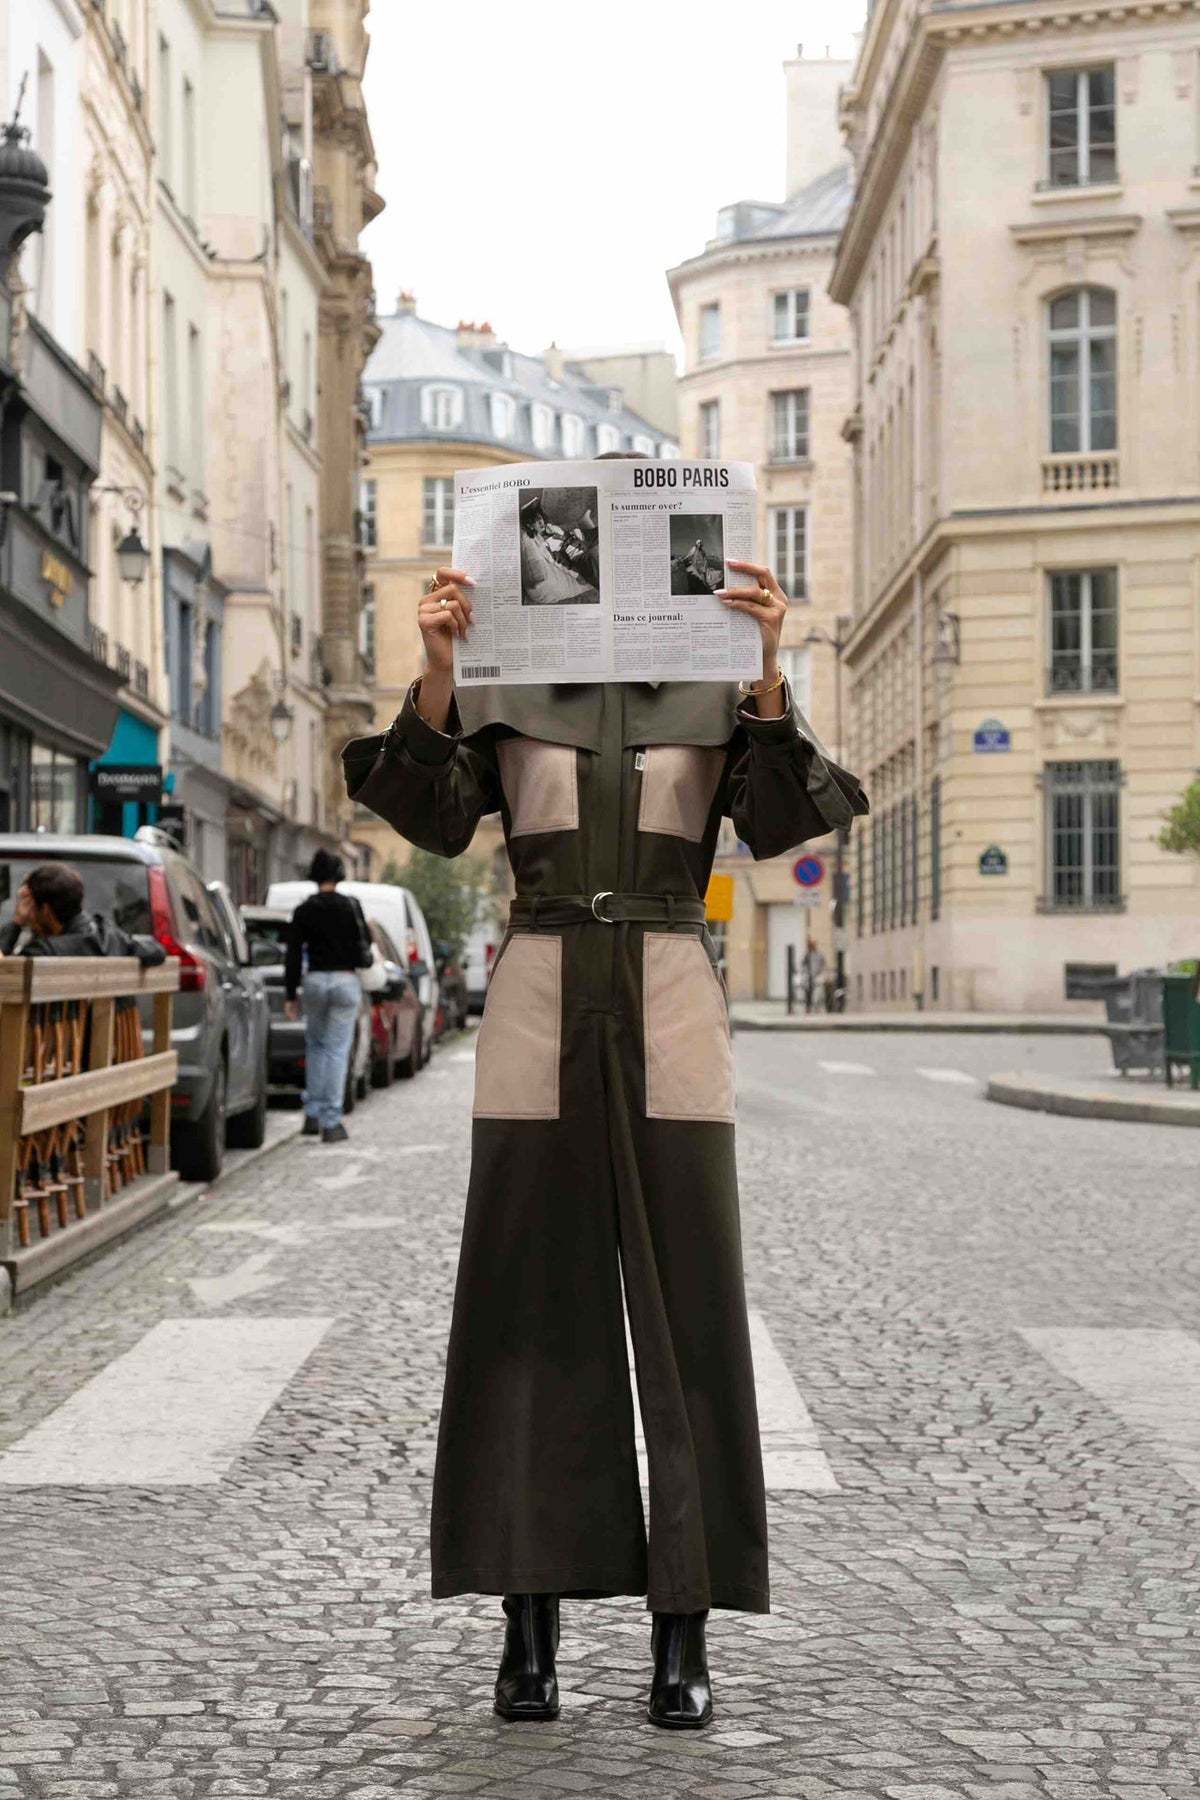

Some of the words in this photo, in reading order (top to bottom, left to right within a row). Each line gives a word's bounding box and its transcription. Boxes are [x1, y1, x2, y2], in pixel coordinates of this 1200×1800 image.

[634, 467, 677, 488] BOBO
[682, 467, 729, 488] PARIS
[460, 482, 501, 494] L’essentiel
[503, 479, 531, 488] BOBO
[611, 503, 619, 511] Is
[621, 503, 656, 511] summer
[658, 501, 683, 511] over?
[613, 614, 635, 622] Dans
[648, 612, 684, 623] journal:
